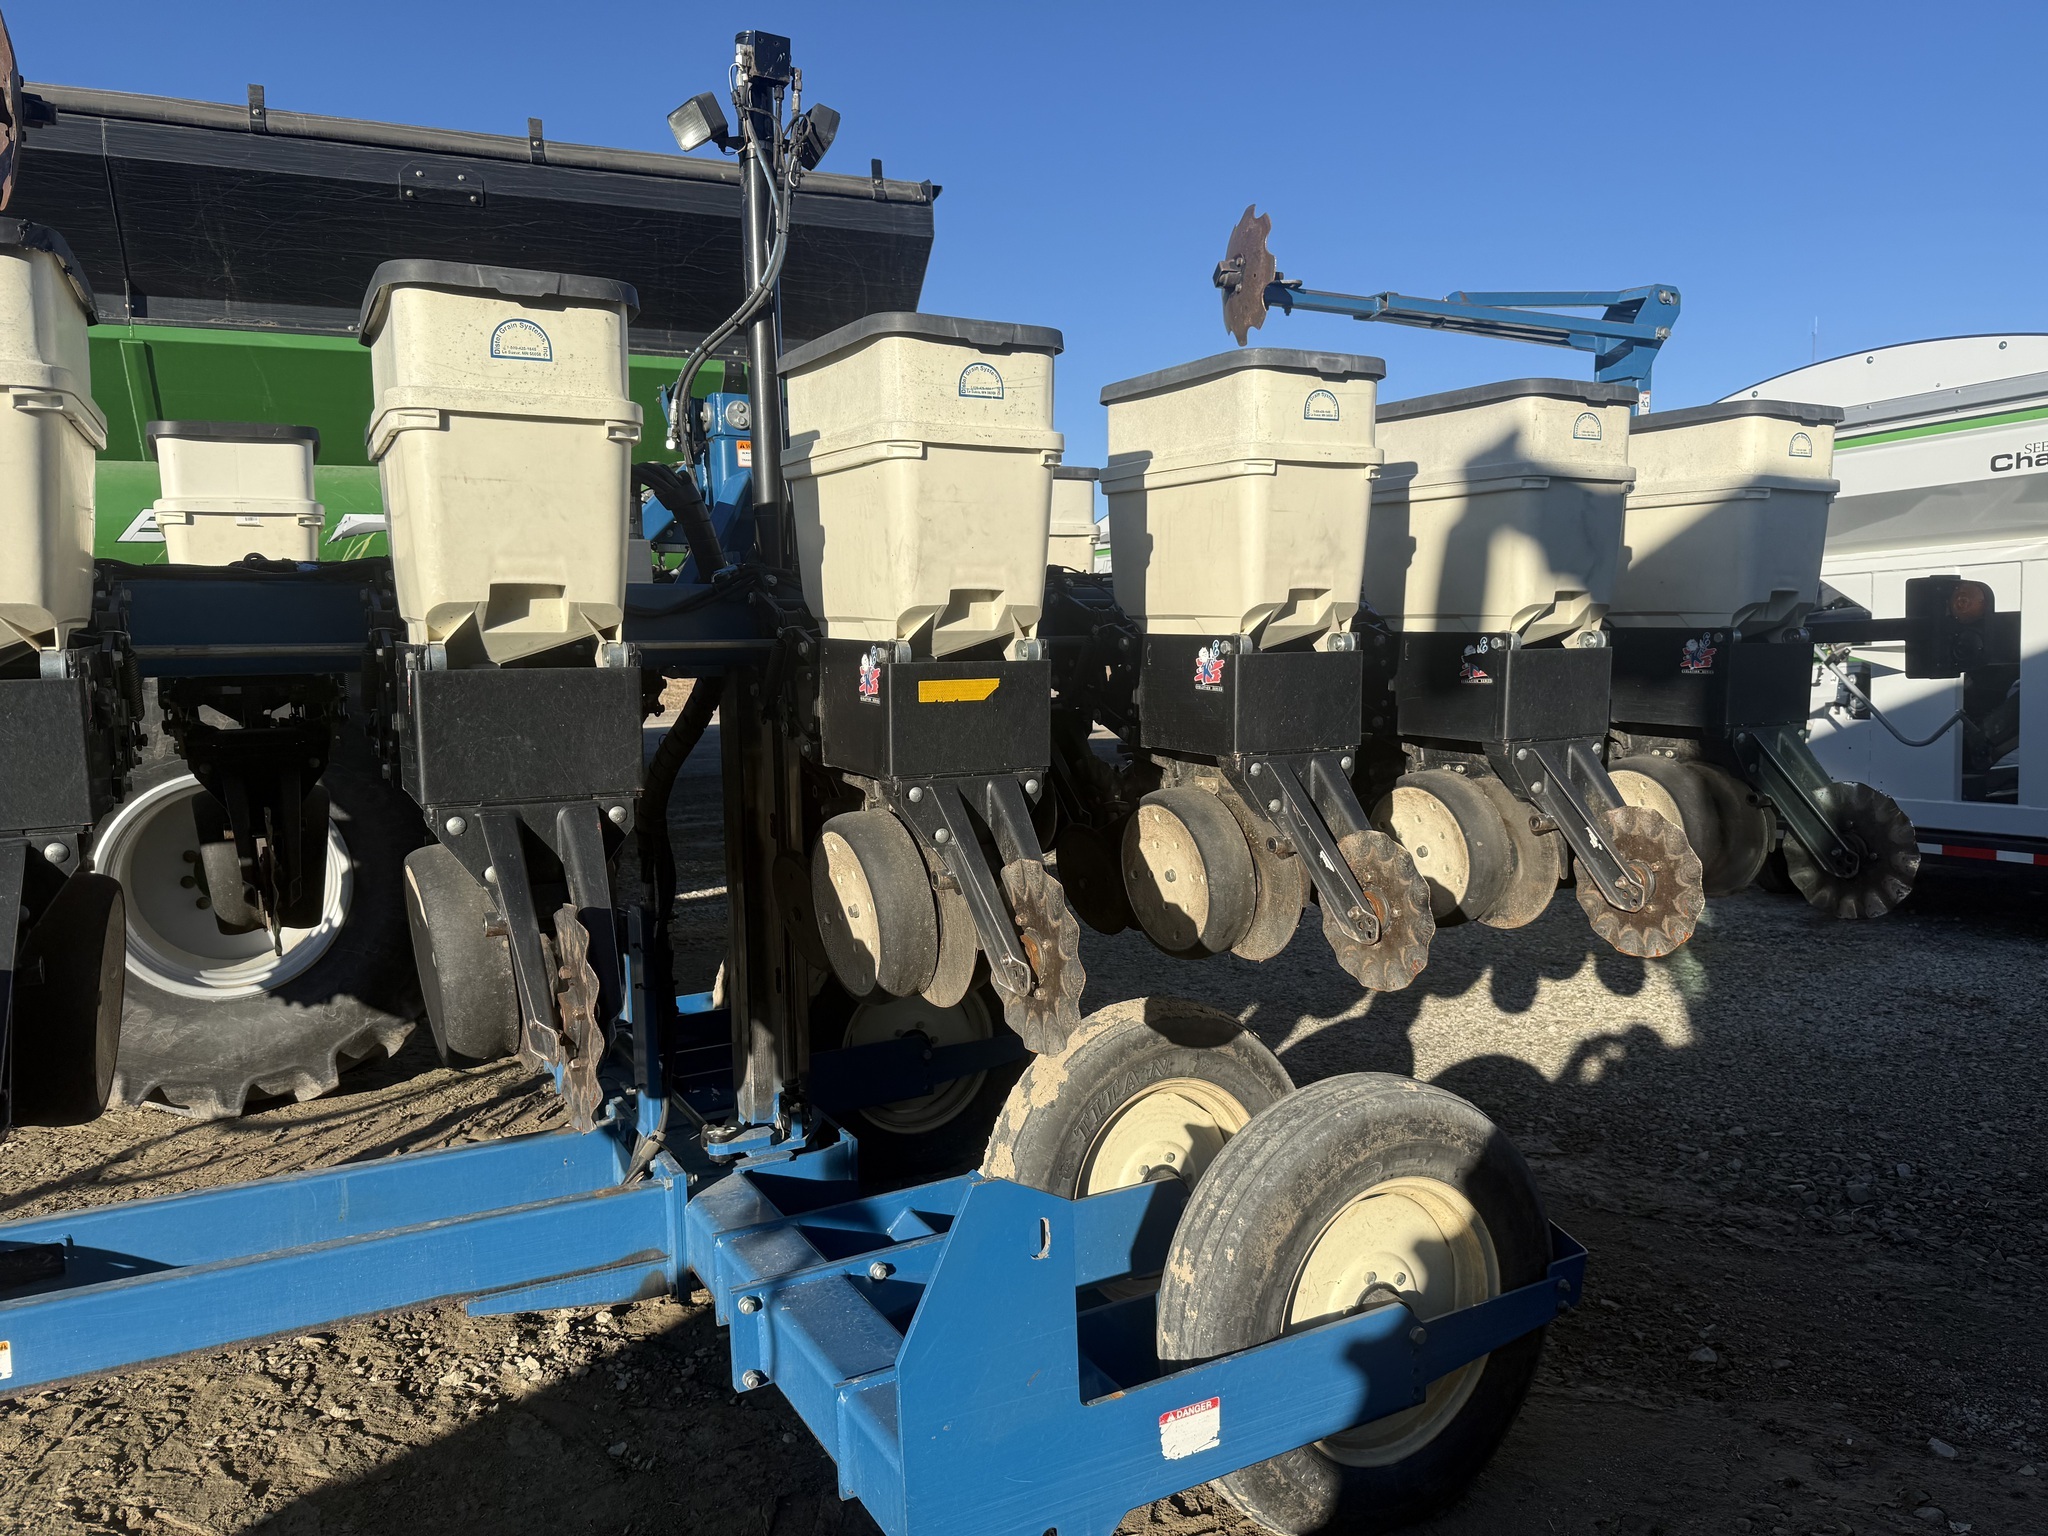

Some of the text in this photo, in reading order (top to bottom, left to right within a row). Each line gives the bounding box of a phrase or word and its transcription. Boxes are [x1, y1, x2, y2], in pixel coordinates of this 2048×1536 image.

[499, 322, 518, 334] Grain
[1073, 1057, 1173, 1144] TITAN
[1176, 1400, 1213, 1419] DANGER
